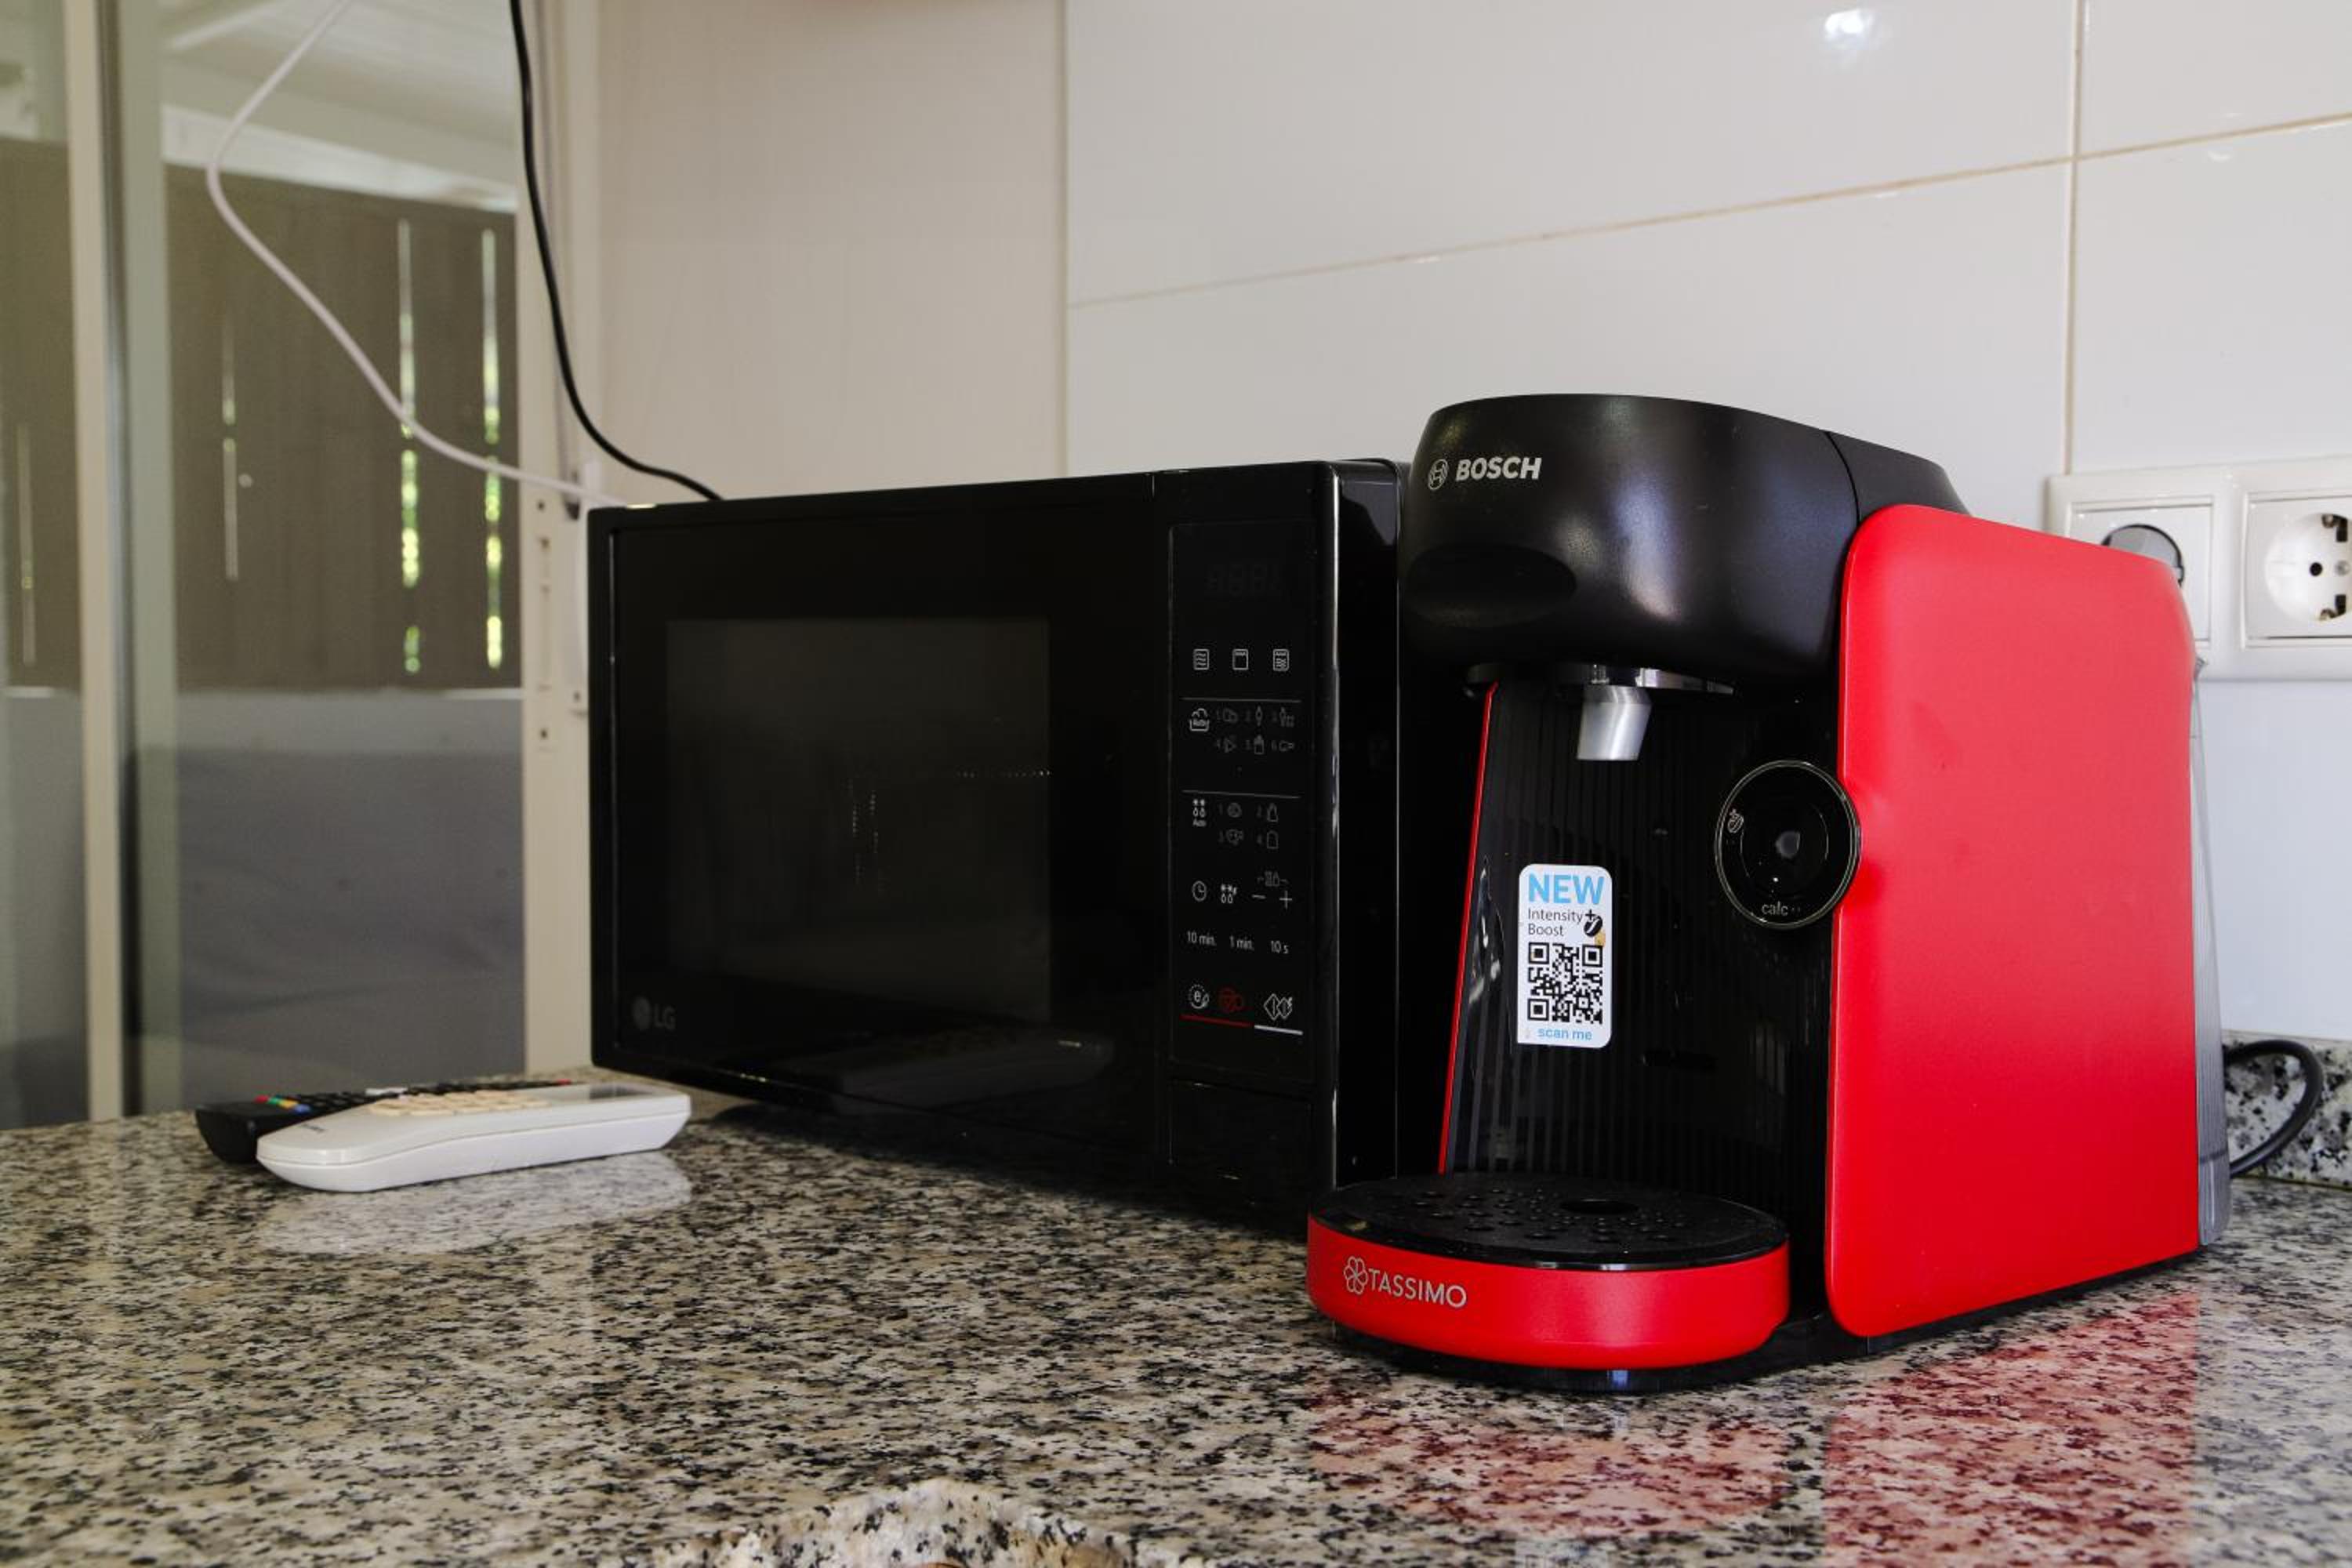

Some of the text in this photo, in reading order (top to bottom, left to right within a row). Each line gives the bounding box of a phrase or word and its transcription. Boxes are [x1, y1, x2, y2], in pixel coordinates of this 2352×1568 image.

[1456, 456, 1542, 481] BOSCH
[1529, 873, 1604, 905] NEW
[1761, 901, 1788, 916] calc
[1528, 908, 1583, 925] Intensity
[1528, 923, 1564, 936] Boost
[1186, 930, 1198, 945] 10
[1229, 935, 1236, 949] 1
[1270, 940, 1290, 954] 10 s
[653, 1004, 677, 1031] LG
[1537, 1028, 1592, 1040] scan me
[1368, 1268, 1467, 1308] TASSIMO
